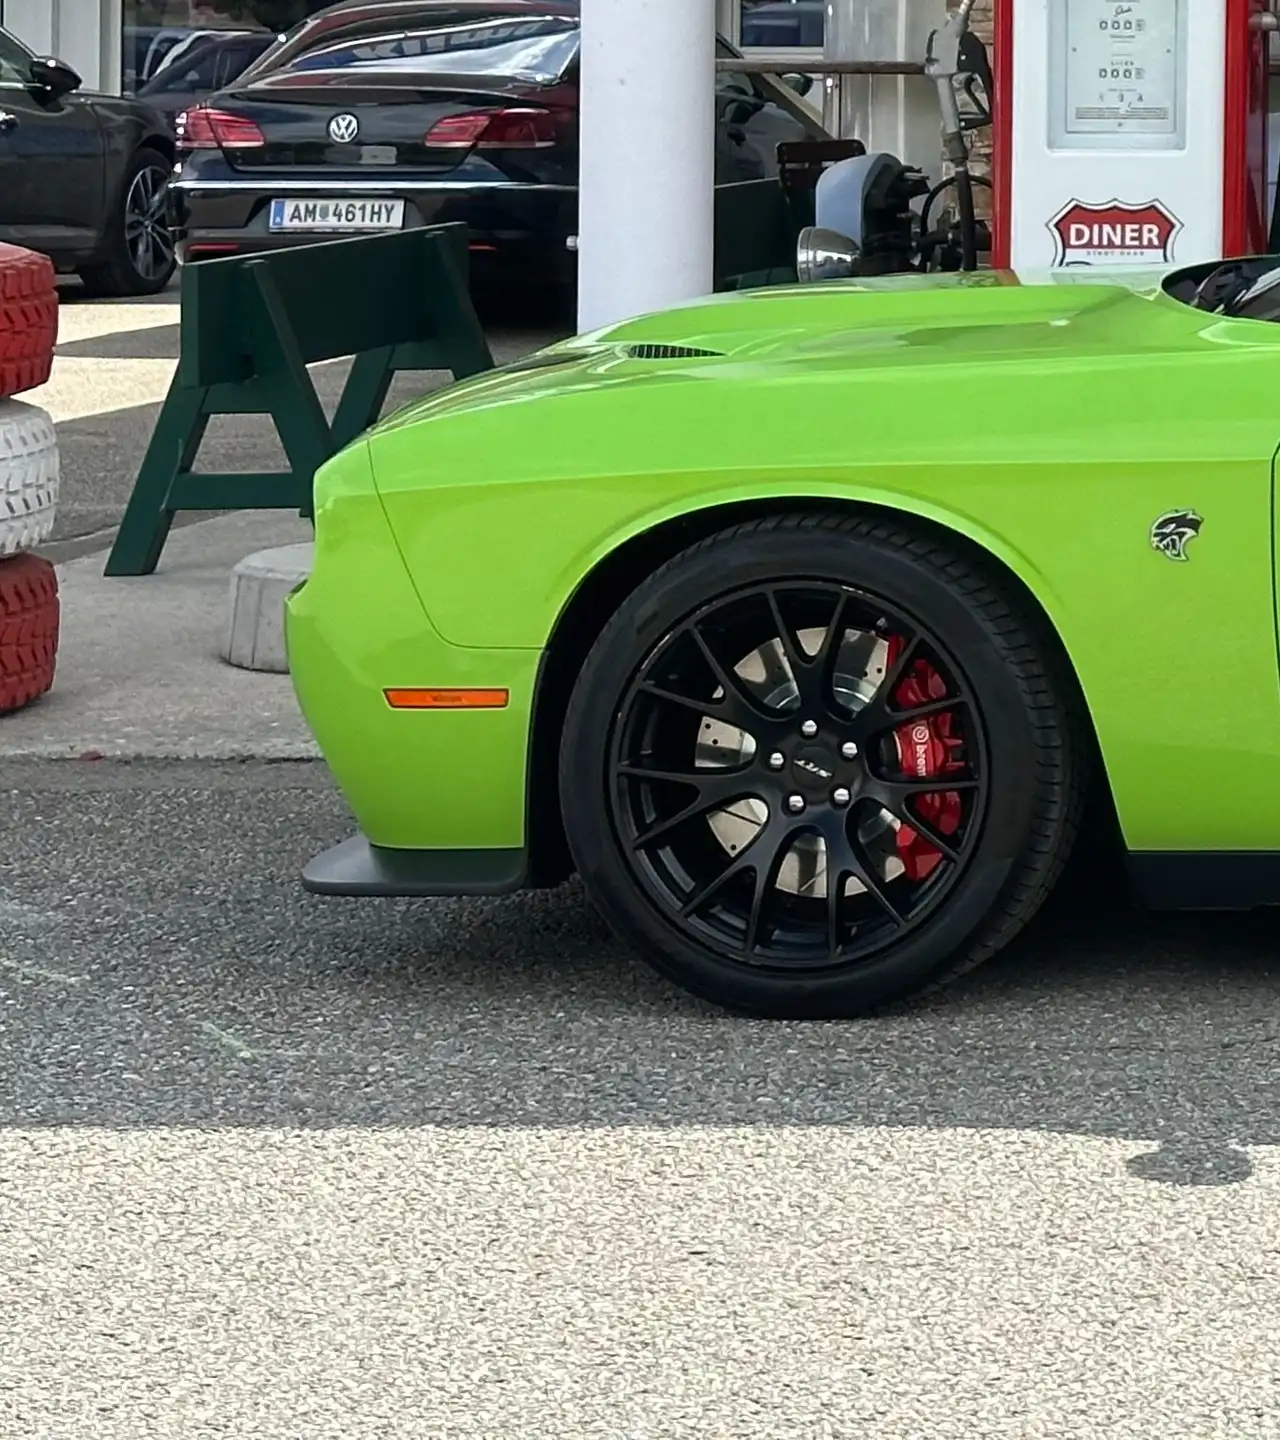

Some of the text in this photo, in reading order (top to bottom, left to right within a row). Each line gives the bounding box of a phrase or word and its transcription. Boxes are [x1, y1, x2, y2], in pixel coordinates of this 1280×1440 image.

[289, 203, 317, 223] AM
[332, 203, 396, 223] 461HY
[1069, 223, 1160, 246] DINER
